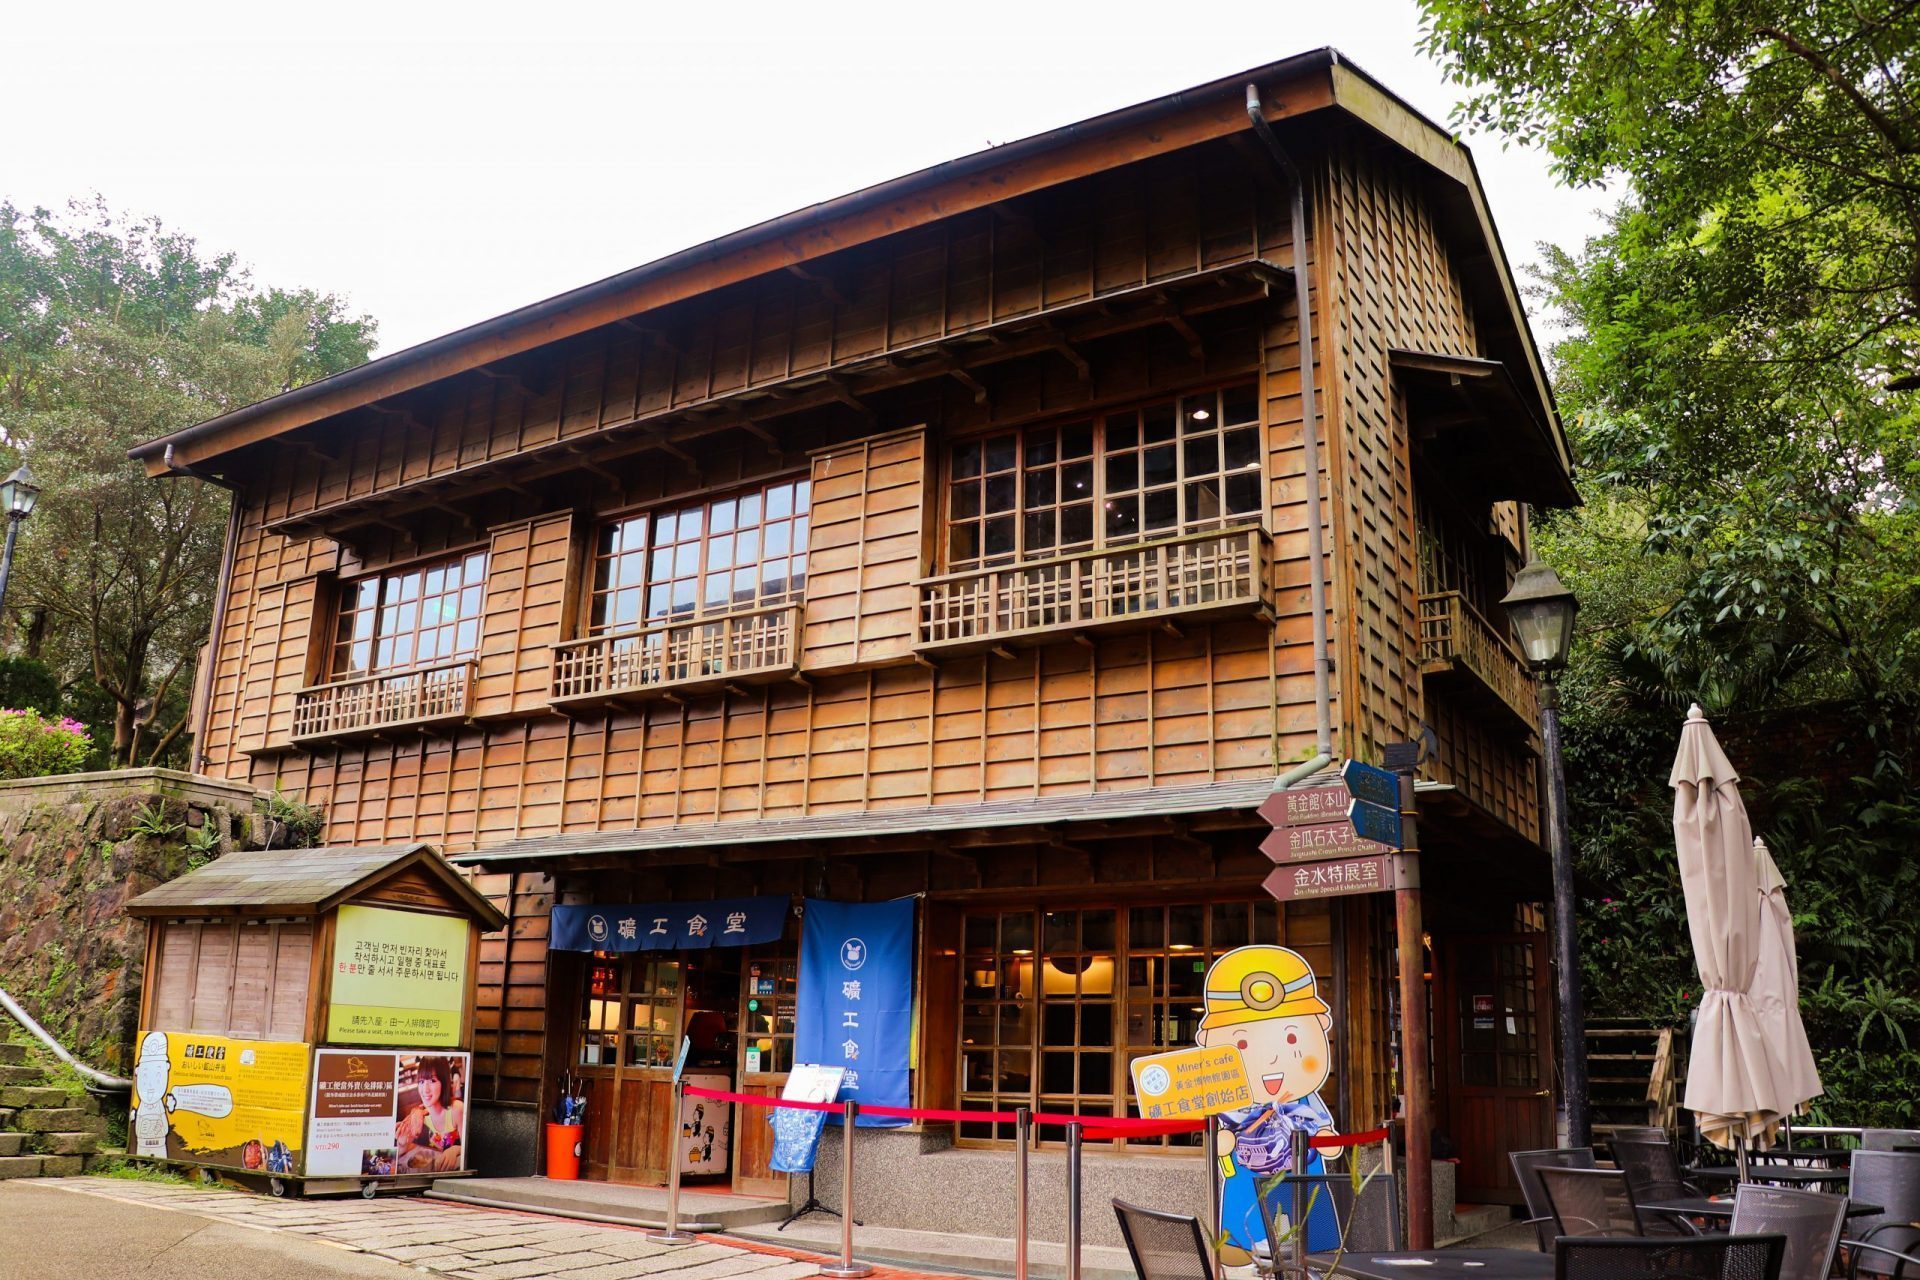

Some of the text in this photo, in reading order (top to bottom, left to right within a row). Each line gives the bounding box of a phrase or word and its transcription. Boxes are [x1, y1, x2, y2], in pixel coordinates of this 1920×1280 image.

[1287, 791, 1352, 813] 黃金館(本山
[1290, 827, 1367, 850] 金瓜石太子
[1318, 848, 1337, 856] Crown
[1338, 846, 1356, 854] Prince
[1293, 861, 1378, 887] 金水特展室
[618, 911, 747, 940] 礦工食堂
[354, 952, 394, 965] 착석하시고
[355, 940, 447, 958] 고객님 먼저 빈자리 찾아서
[378, 966, 394, 977] 서서
[395, 967, 434, 980] 주문하시면
[339, 1026, 355, 1034] Please
[842, 980, 861, 1091] 礦工食堂
[1176, 1058, 1211, 1073] Miner's
[1148, 1085, 1249, 1119] 礦工食堂創始店
